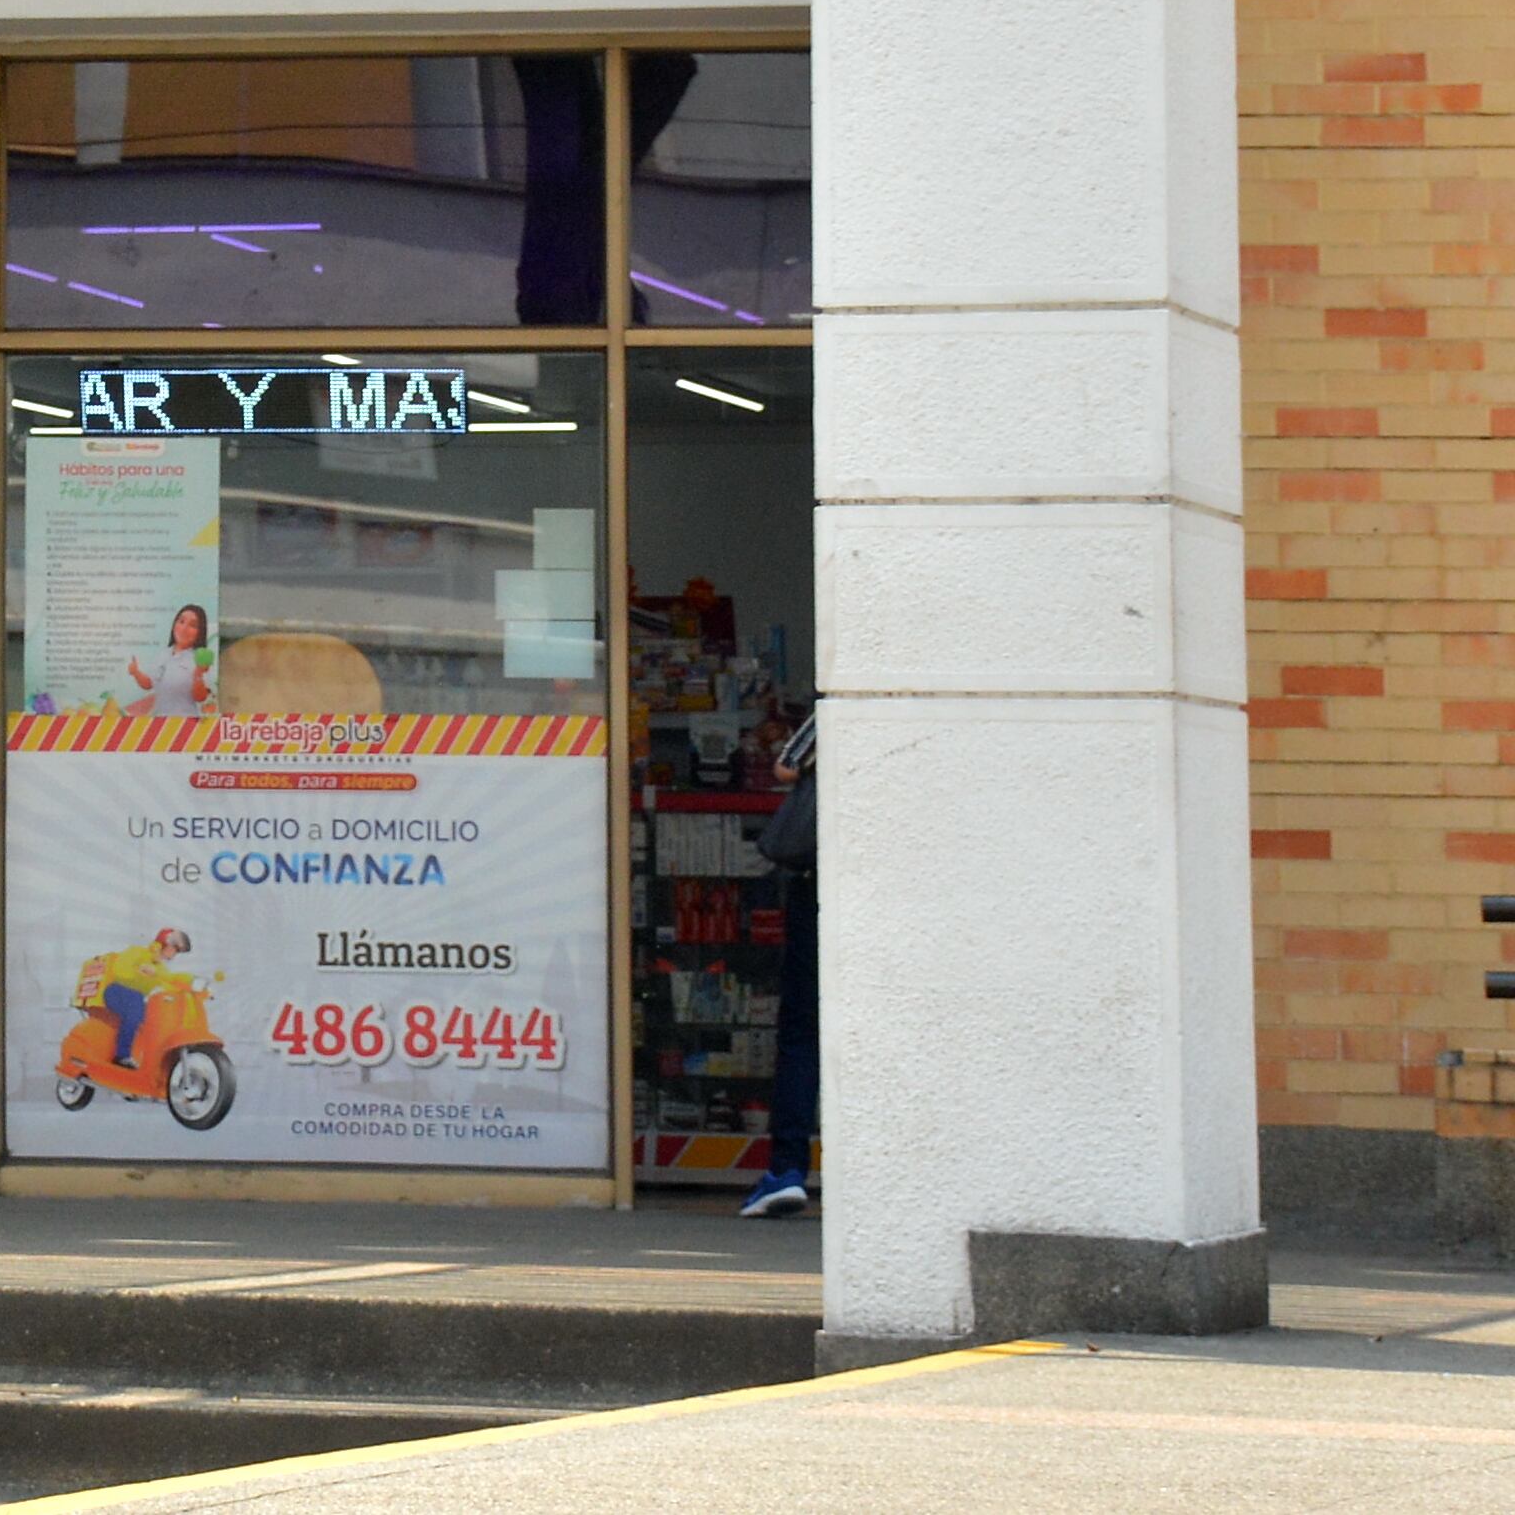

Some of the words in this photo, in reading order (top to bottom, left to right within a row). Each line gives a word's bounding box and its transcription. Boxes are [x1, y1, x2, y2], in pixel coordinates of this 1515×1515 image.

[217, 371, 276, 431] Y
[249, 719, 324, 749] rebaja
[329, 717, 386, 746] plus
[197, 772, 236, 787] Para
[298, 775, 338, 790] para
[342, 773, 413, 791] siempre
[127, 816, 165, 839] Un
[172, 817, 301, 840] SERVICIO
[307, 823, 323, 841] a
[331, 818, 480, 843] DOMICILIO
[161, 857, 202, 884] de
[210, 851, 447, 886] CONFIANZA
[317, 929, 512, 970] Llámanos
[272, 1002, 385, 1058] 486
[403, 1005, 558, 1061] 8444
[323, 1102, 405, 1118] COMPRA
[410, 1103, 471, 1119] DESDE
[481, 1105, 505, 1120] LA
[291, 1120, 408, 1137] COMODIDAD
[413, 1122, 437, 1137] DE
[444, 1123, 467, 1139] TU
[472, 1124, 540, 1140] HOGAR
